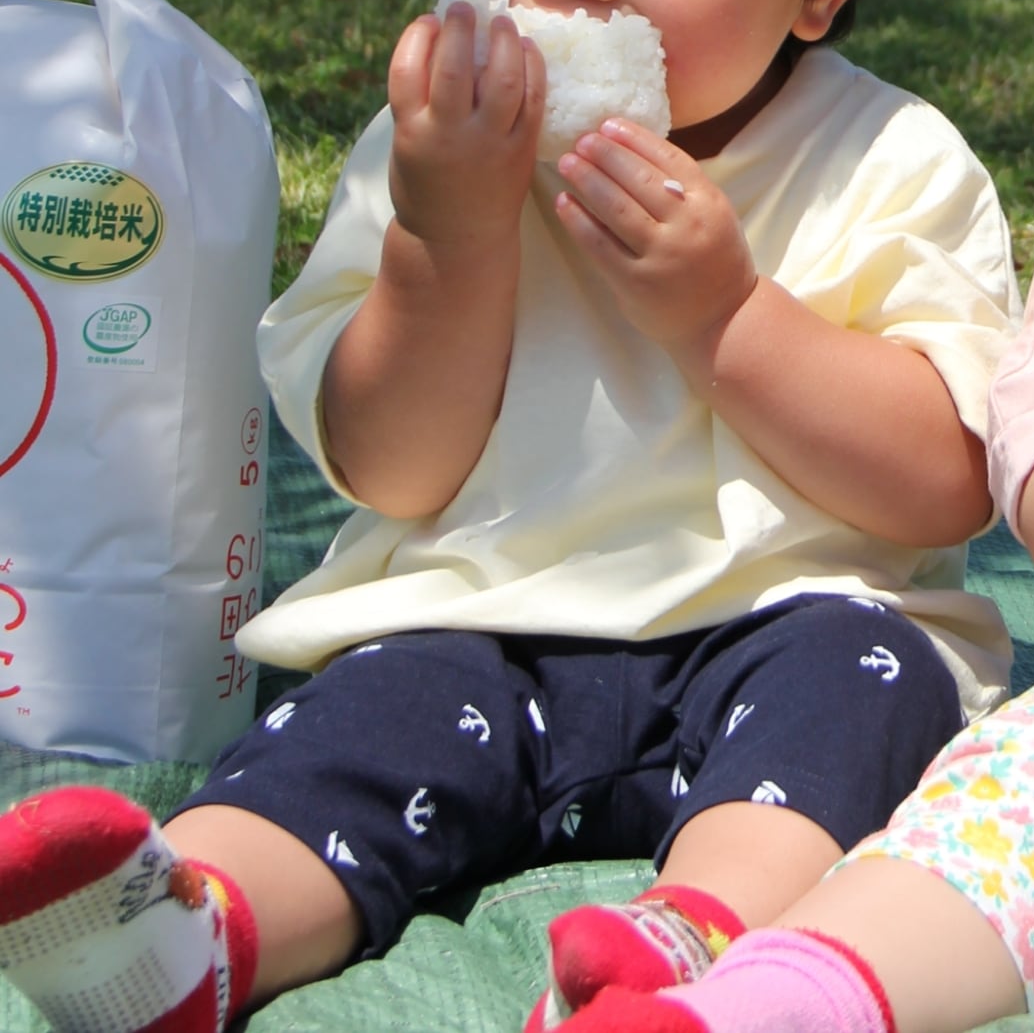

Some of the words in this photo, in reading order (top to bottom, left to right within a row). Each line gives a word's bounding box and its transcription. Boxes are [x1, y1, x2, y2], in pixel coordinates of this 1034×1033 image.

[17, 190, 144, 243] 特別栽培米
[100, 308, 138, 322] JGAP
[240, 460, 259, 486] 5
[216, 533, 246, 699] 山田の
